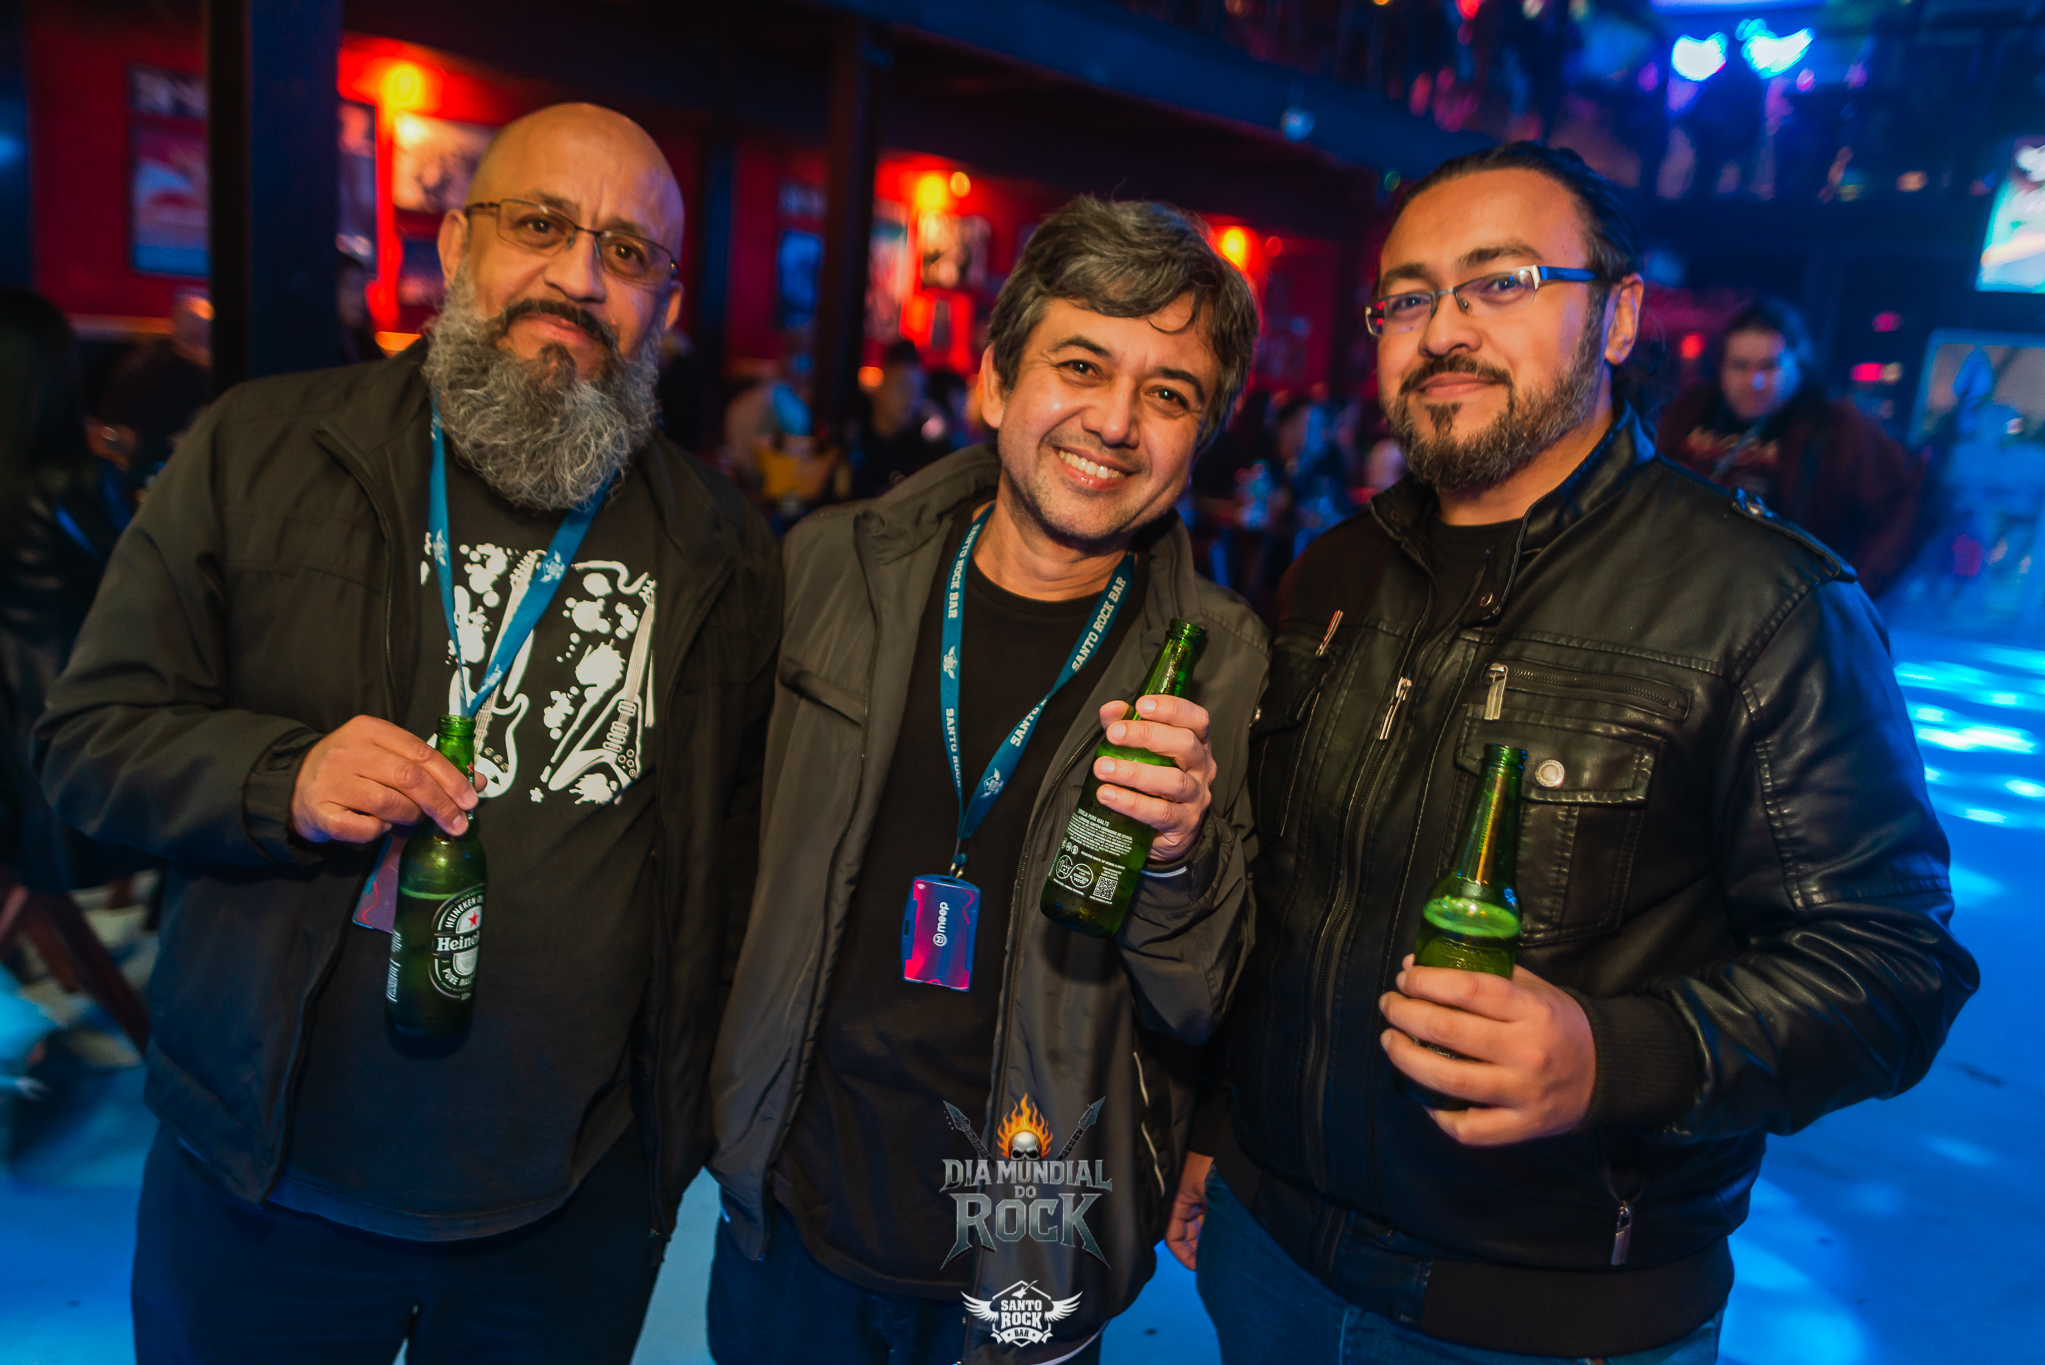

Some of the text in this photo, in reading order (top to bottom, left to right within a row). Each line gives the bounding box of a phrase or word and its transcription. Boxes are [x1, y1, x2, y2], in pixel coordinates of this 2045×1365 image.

[948, 523, 981, 619] SANTO ROCK BAR
[1071, 576, 1126, 673] SANTO ROCK BAR
[946, 708, 957, 752] SANTO
[1010, 706, 1040, 747] SANTO
[444, 896, 476, 928] HEINEKEN
[937, 901, 949, 932] meep
